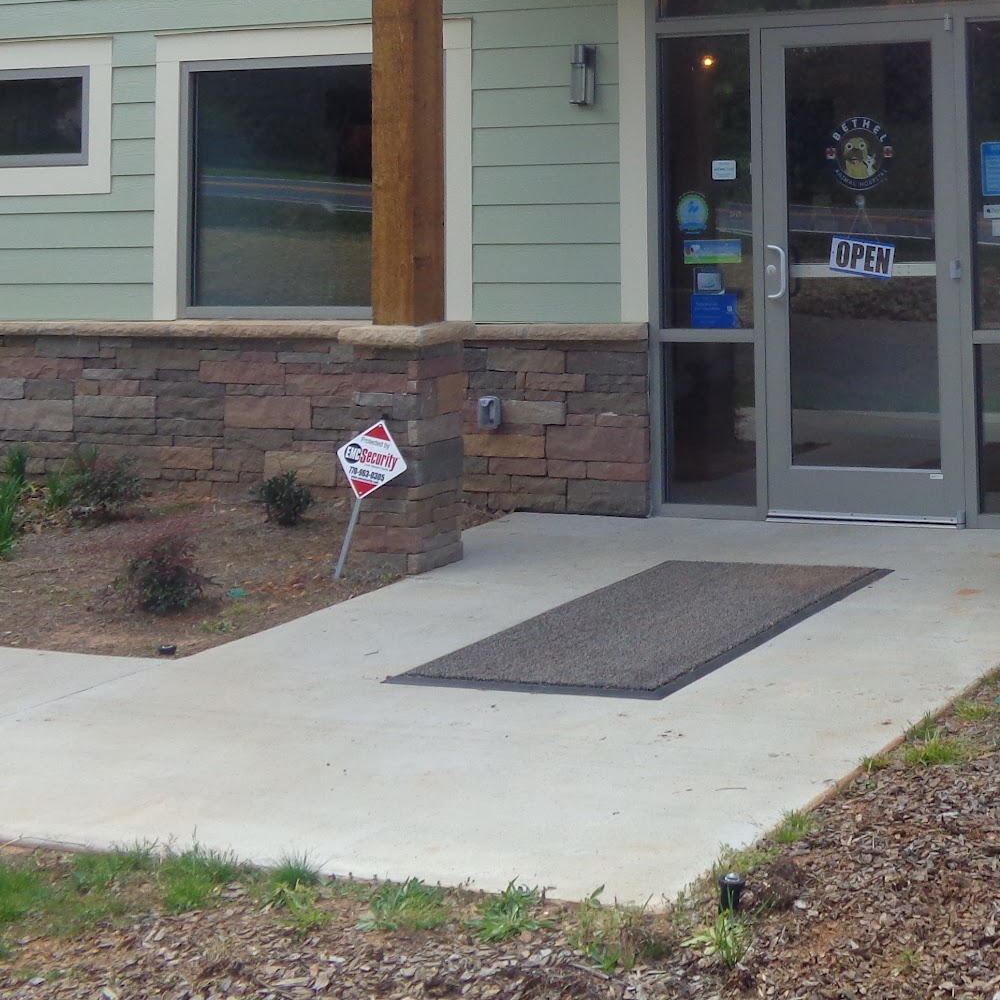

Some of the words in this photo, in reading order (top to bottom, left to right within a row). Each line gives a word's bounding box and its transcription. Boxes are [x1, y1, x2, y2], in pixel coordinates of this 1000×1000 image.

[832, 119, 887, 143] BETHEL
[835, 169, 857, 187] ANIMAL
[859, 169, 888, 187] HOSPITAL
[836, 241, 891, 275] OPEN
[360, 437, 384, 448] Protected
[383, 441, 390, 450] by
[345, 446, 361, 461] EMC
[360, 449, 398, 472] Security
